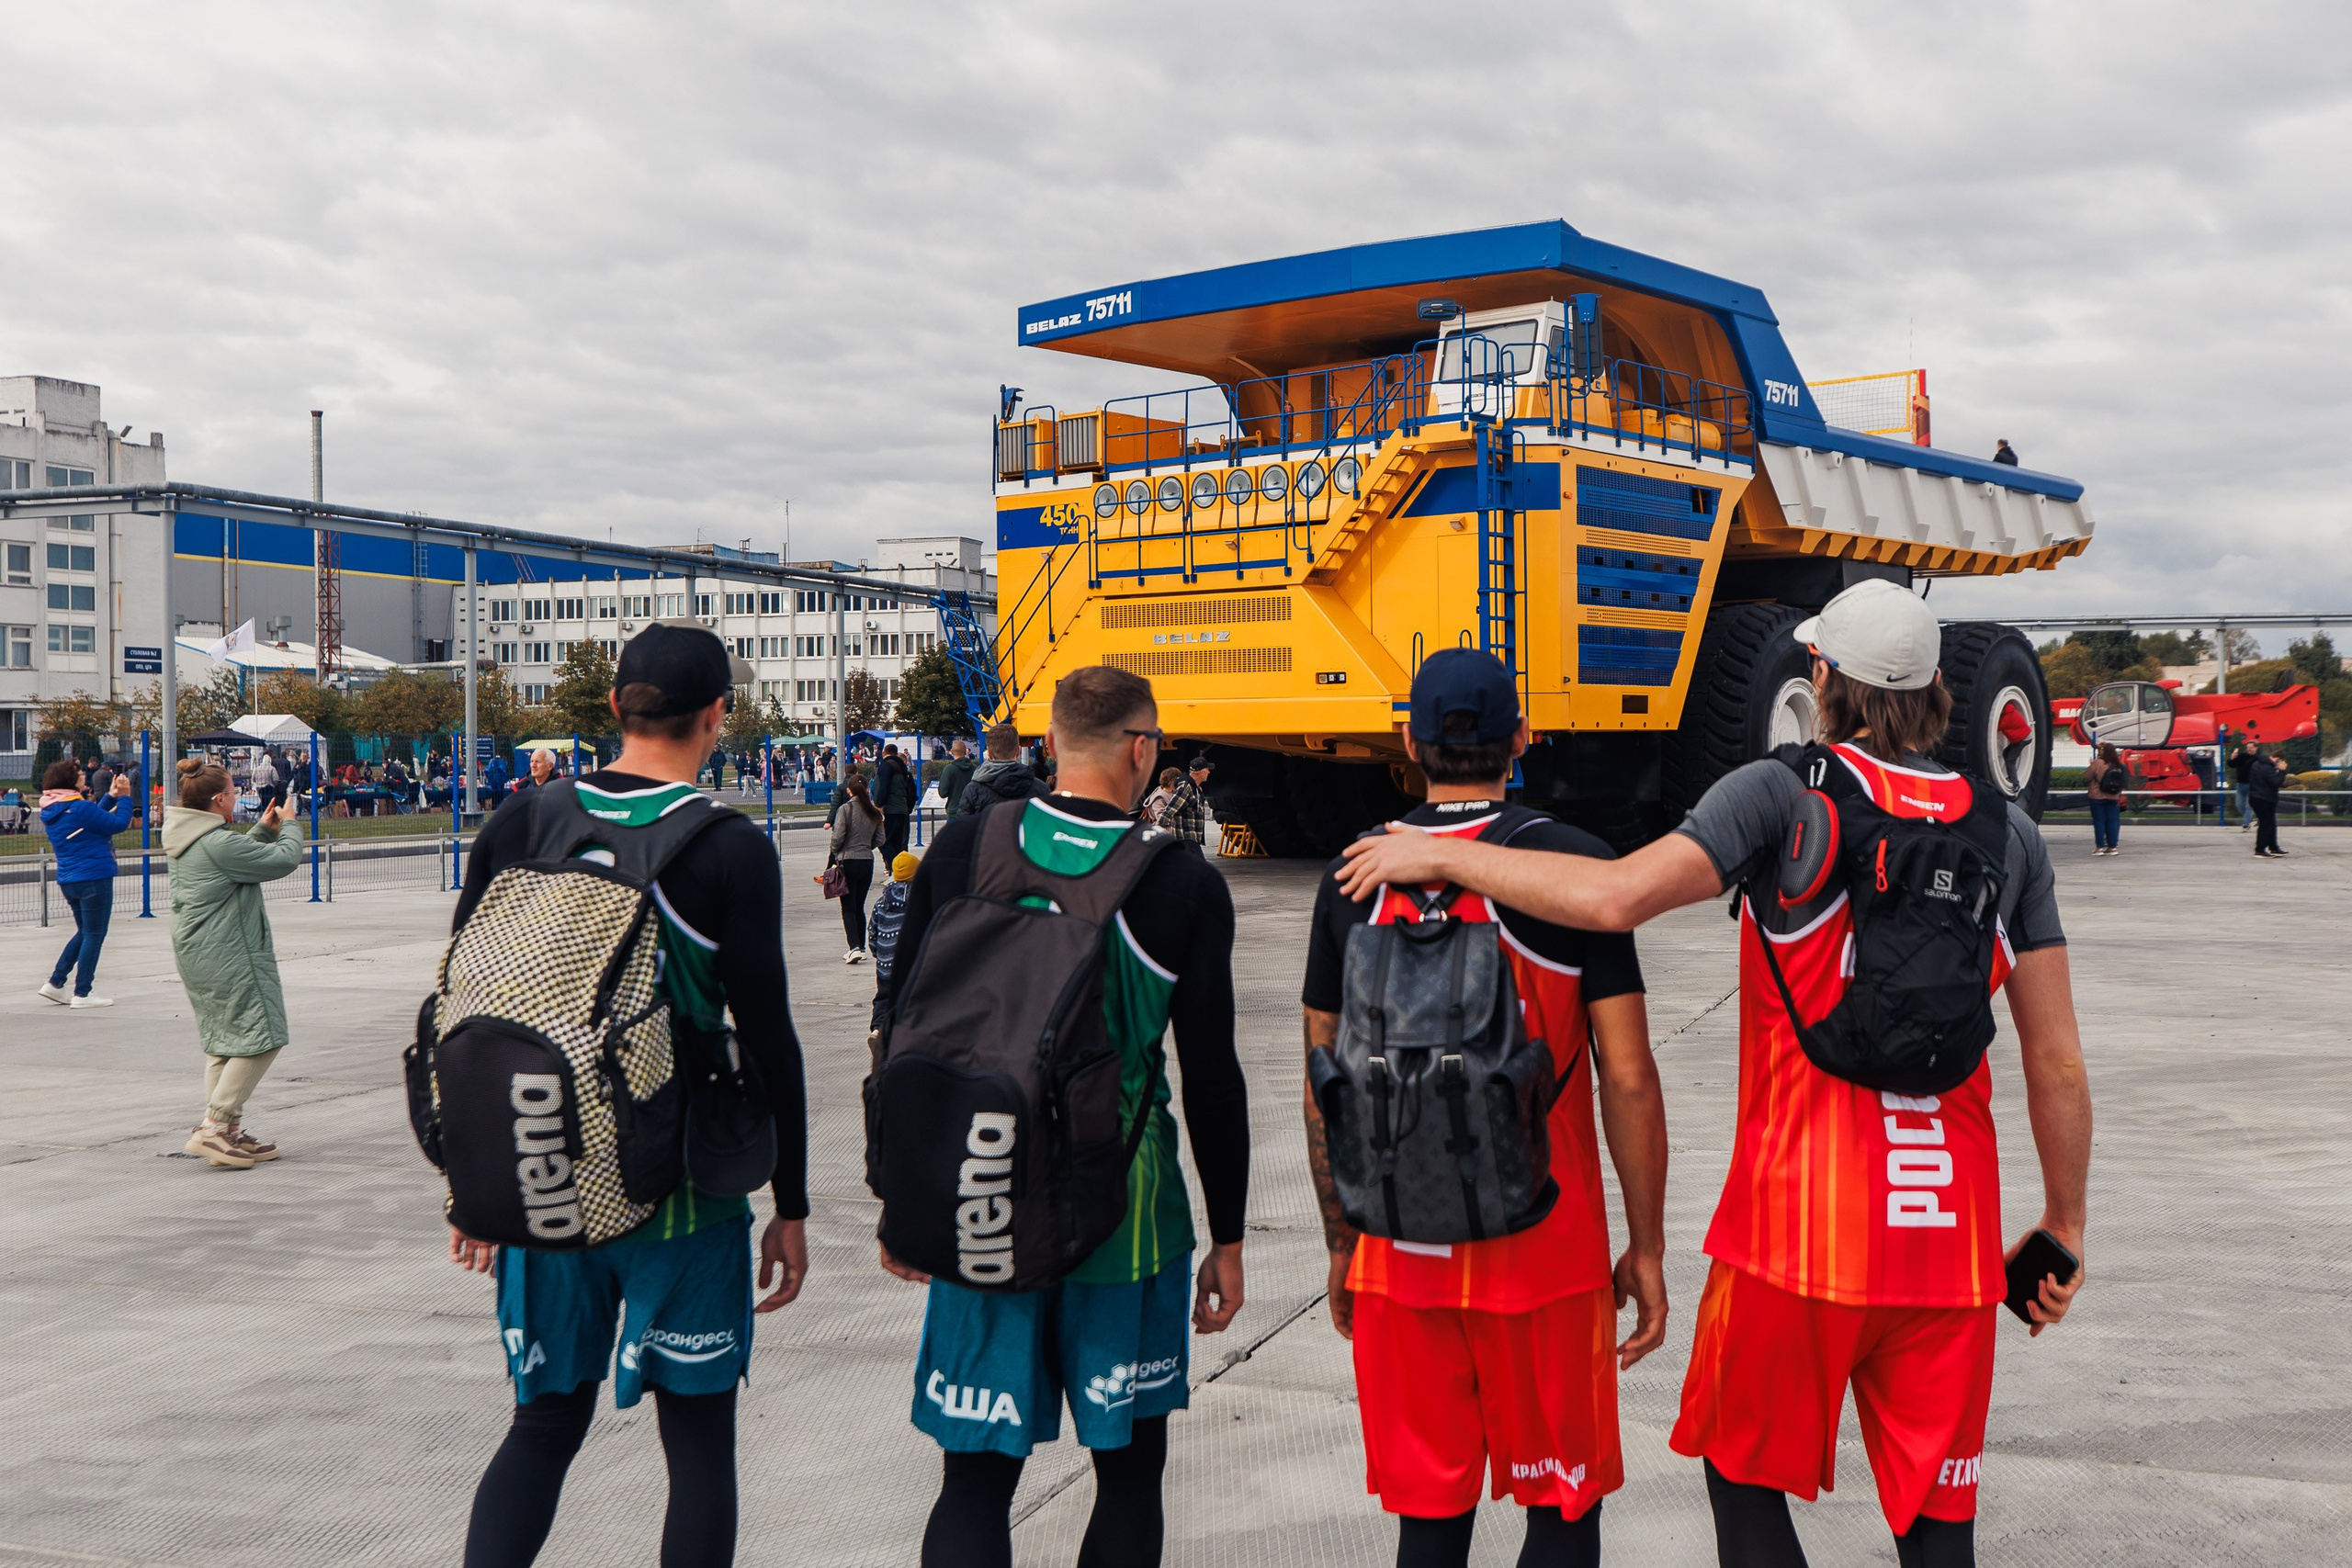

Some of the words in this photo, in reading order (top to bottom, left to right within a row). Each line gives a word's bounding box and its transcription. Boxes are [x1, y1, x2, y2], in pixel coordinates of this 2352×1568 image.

[1026, 313, 1082, 334] BELAZ
[1086, 290, 1132, 321] 75711
[1764, 378, 1799, 407] 75711
[1039, 503, 1080, 527] 450
[1153, 631, 1230, 645] BELAZ
[1435, 802, 1465, 813] NIKE
[1464, 800, 1490, 812] PRO
[510, 1072, 585, 1239] arena
[955, 1111, 1016, 1285] arena
